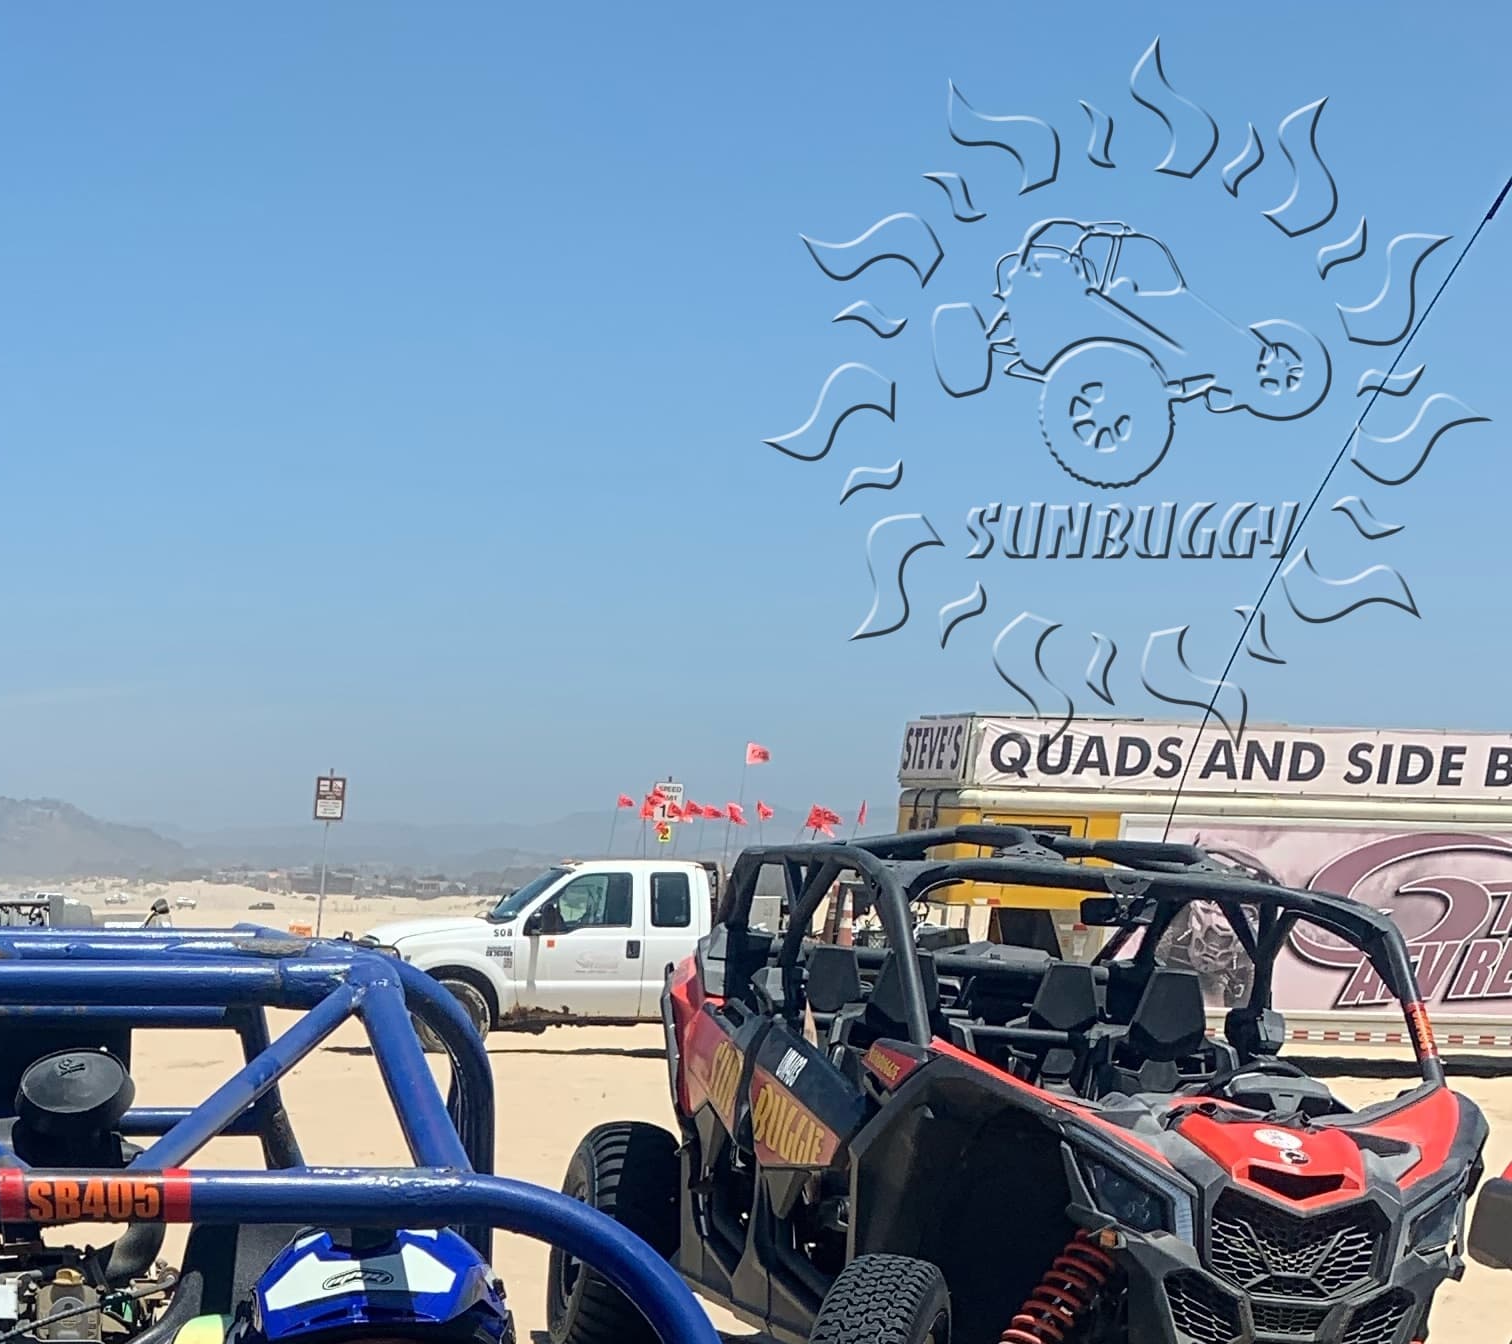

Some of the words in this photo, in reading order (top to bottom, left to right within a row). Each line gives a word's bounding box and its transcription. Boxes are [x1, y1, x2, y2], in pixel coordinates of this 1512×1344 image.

[901, 725, 964, 771] STEVE'S
[990, 732, 1185, 779] QUADS
[1198, 738, 1327, 782] AND
[1343, 742, 1467, 786] SIDE
[28, 1178, 160, 1221] SB405
